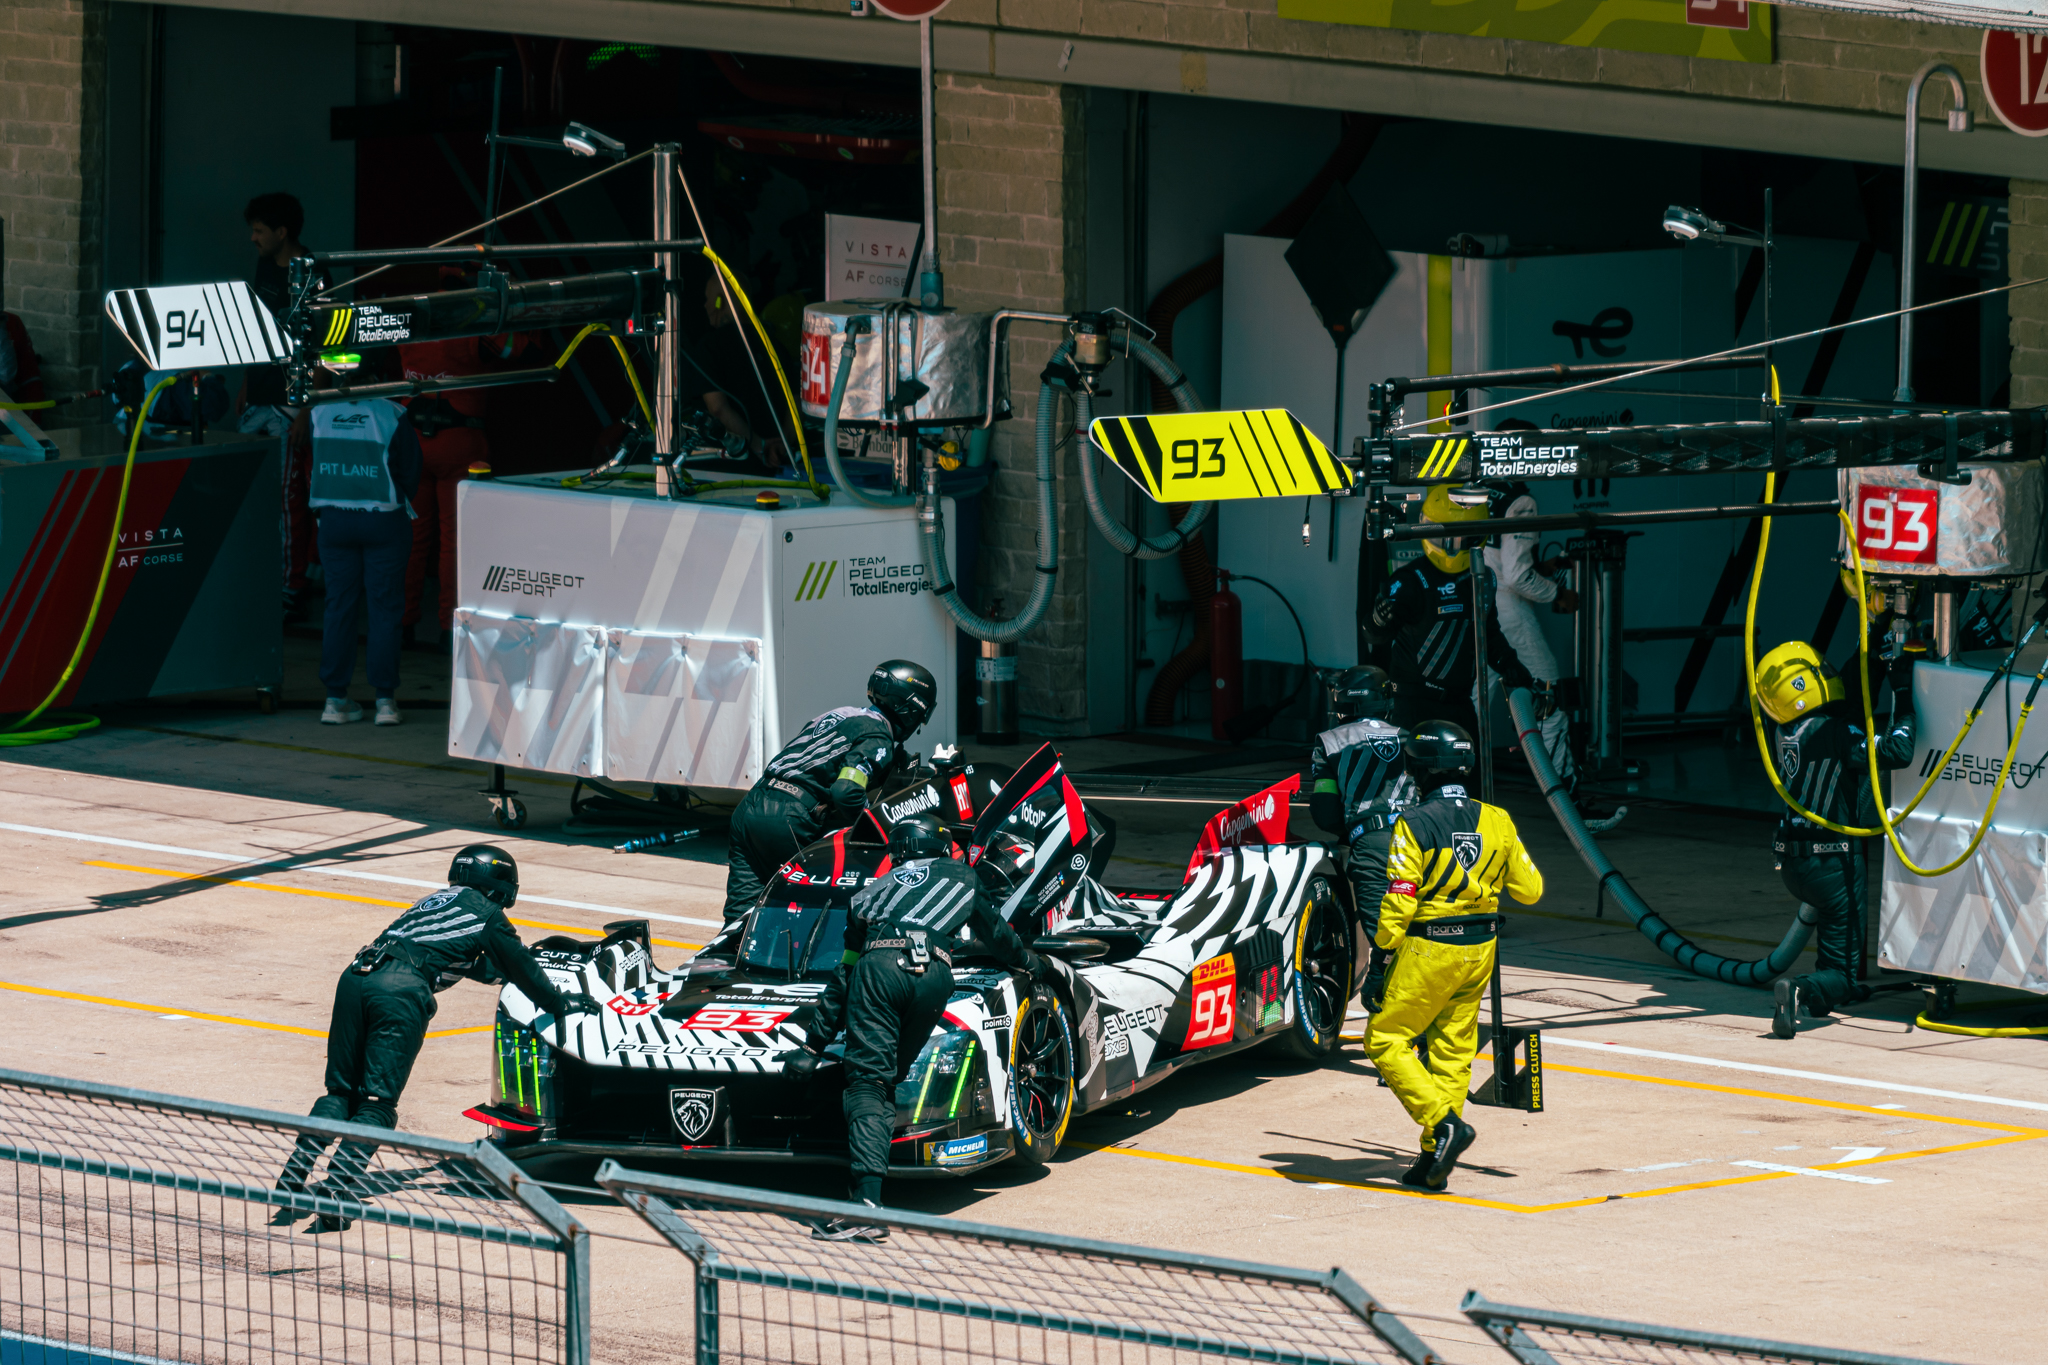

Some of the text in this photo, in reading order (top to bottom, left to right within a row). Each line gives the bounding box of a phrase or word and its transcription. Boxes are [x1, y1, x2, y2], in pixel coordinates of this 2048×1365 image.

[845, 240, 907, 259] VISTA
[845, 269, 865, 284] AF
[358, 306, 382, 316] TEAM
[166, 309, 205, 349] 94
[358, 313, 412, 328] PEUGEOT
[358, 326, 410, 343] TotalEnergies
[1481, 436, 1522, 447] TEAM
[1171, 437, 1226, 480] 93
[1480, 445, 1579, 461] PEUGEOT
[320, 462, 379, 478] PIT LANE
[1480, 460, 1577, 477] TotalEnergies
[1863, 498, 1930, 551] 93
[118, 527, 183, 544] VISTA
[118, 552, 183, 568] AF CORSE
[849, 556, 886, 567] TEAM
[504, 567, 585, 589] PEUGEOT
[849, 564, 928, 581] PEUGEO
[500, 580, 556, 598] SPORT
[850, 577, 933, 597] TotalEnergies
[953, 781, 969, 812] HY
[1220, 799, 1265, 845] Capgemini
[1812, 842, 1849, 852] sparco
[1199, 958, 1230, 980] DHL
[612, 997, 650, 1015] HY
[715, 994, 819, 1003] TotalEnergies
[687, 1010, 783, 1031] 93
[1190, 983, 1233, 1042] 93
[612, 1043, 798, 1057] PEUGEOT
[1529, 1033, 1541, 1109] PRESS CLUTCH
[948, 1139, 985, 1155] MICHELIN
